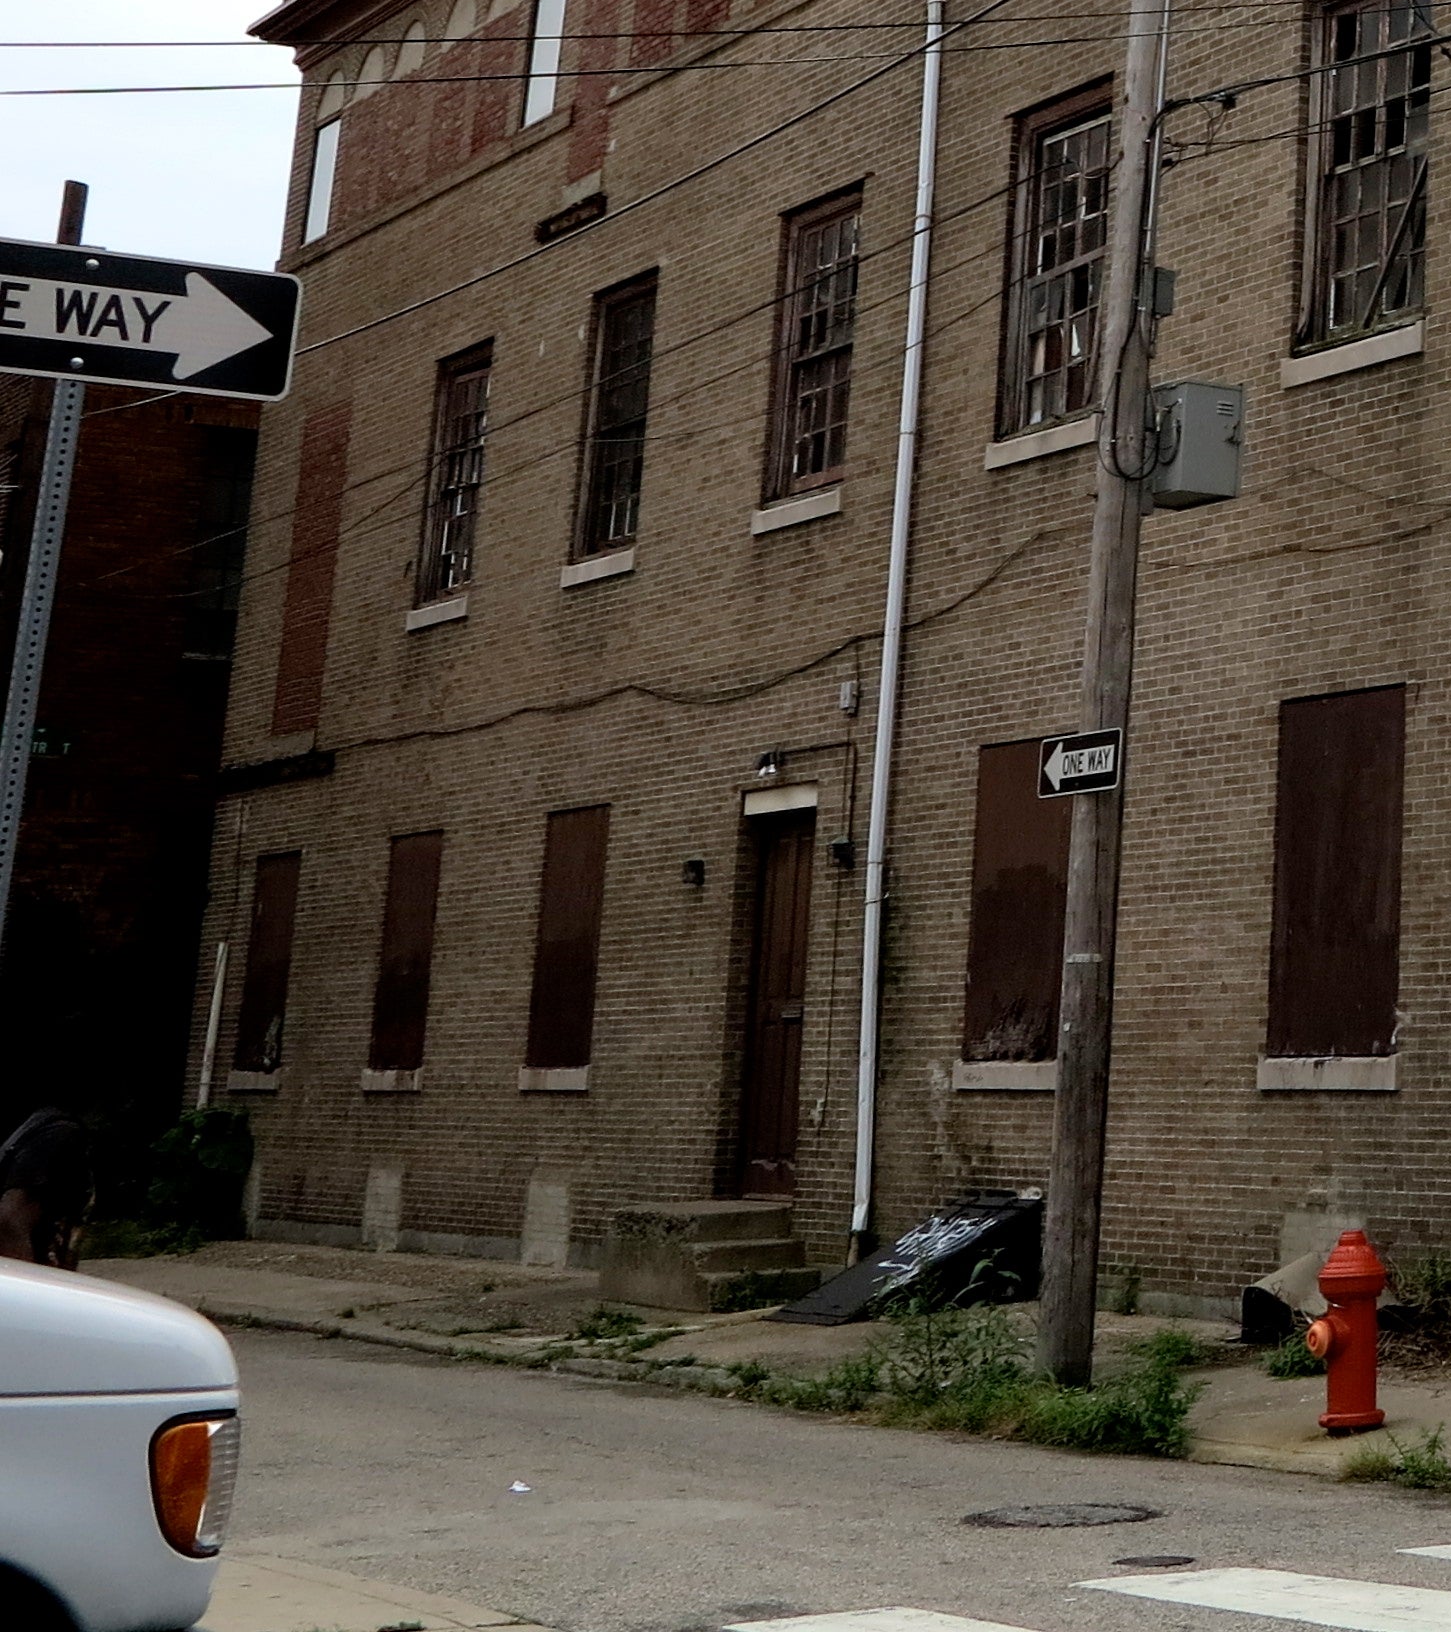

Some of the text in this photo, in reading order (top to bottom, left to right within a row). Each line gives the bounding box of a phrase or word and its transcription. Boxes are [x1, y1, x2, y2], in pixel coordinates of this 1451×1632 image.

[55, 288, 172, 344] WAY
[1063, 749, 1111, 775] ONE WAY
